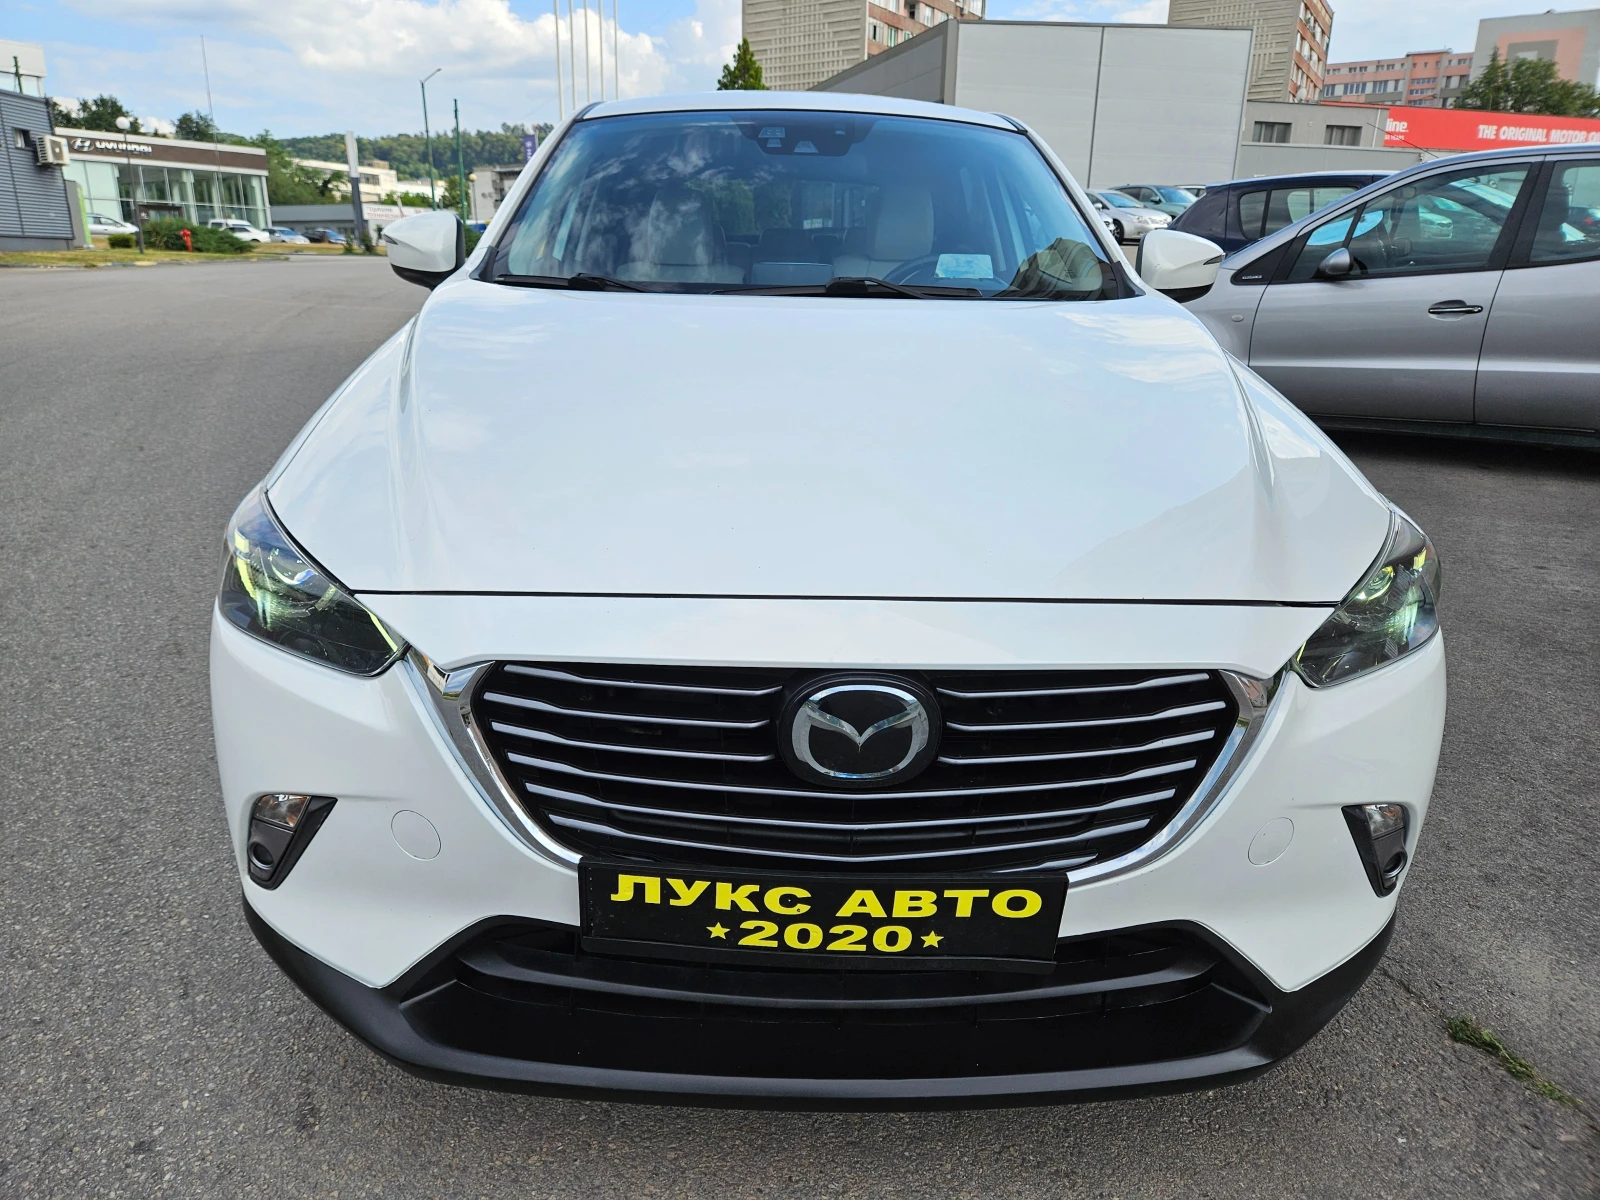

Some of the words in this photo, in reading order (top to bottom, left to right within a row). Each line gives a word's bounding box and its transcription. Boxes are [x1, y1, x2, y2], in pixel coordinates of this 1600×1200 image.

[1478, 124, 1498, 140] THE
[1500, 126, 1547, 142] ORIGINAL
[1549, 129, 1587, 144] MOTOR
[611, 874, 812, 915] ЛУКС
[835, 889, 1042, 918] АВТО
[738, 921, 912, 952] 2020
